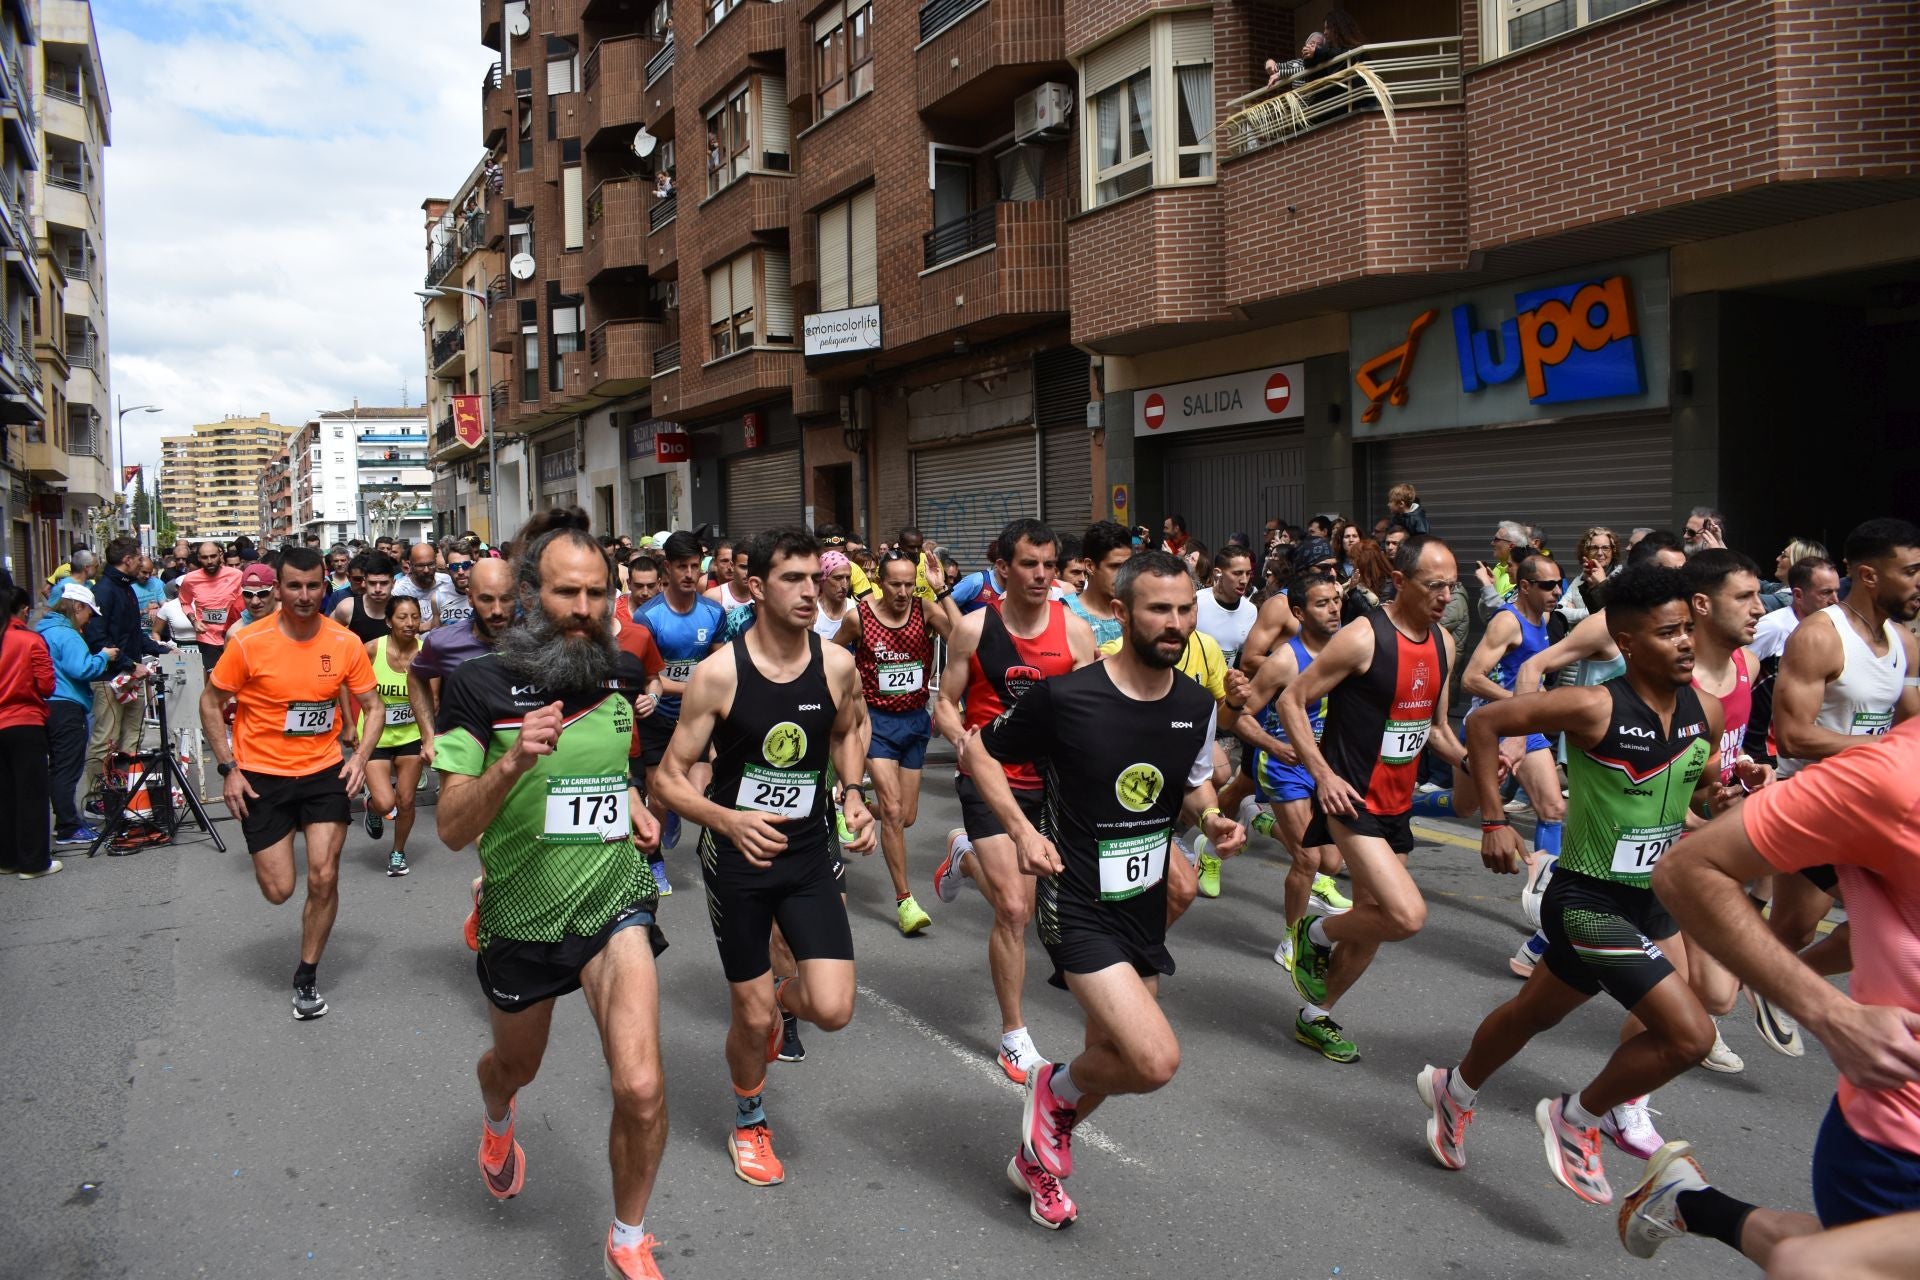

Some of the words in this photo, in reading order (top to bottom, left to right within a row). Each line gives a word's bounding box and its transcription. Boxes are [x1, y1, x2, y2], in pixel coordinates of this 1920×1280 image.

[805, 314, 877, 337] @monicolorlife
[1452, 275, 1634, 400] lupa
[1183, 388, 1243, 417] SALIDA
[207, 612, 223, 621] 182
[665, 666, 690, 678] 184
[888, 671, 915, 687] 224
[1398, 699, 1433, 709] SUANZES
[298, 711, 328, 728] 128
[1397, 731, 1425, 753] 126
[560, 777, 570, 786] XV
[571, 777, 600, 785] CARRERA
[601, 775, 623, 784] POPULAR
[762, 769, 787, 778] CARRERA
[551, 786, 582, 794] CALAHORRA
[582, 785, 601, 793] CIUDAD
[753, 783, 801, 808] 252
[568, 794, 618, 826] 173
[1118, 839, 1144, 848] CARRERA
[1144, 832, 1164, 843] POPULAR
[1102, 849, 1130, 857] CALAHORRA
[1126, 852, 1150, 882] 61
